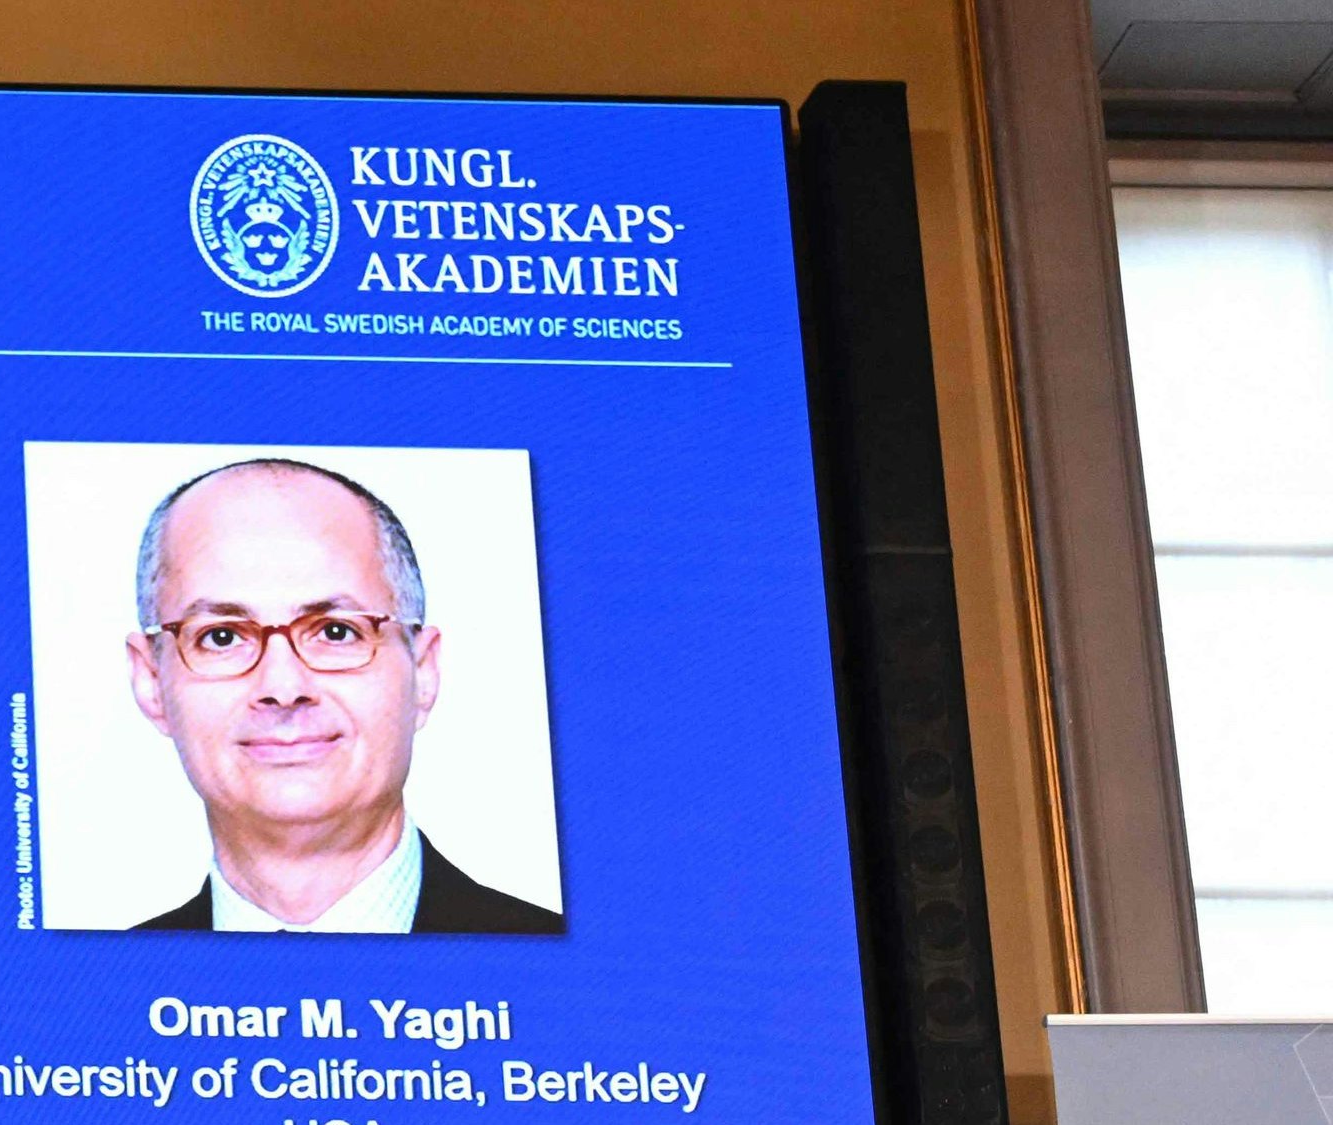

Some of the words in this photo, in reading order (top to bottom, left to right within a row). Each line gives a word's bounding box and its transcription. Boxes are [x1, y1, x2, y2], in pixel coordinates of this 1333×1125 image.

[350, 146, 537, 189] KUNGL.
[351, 199, 685, 244] VETENSKAPS-
[357, 252, 678, 297] AKADEMIEN
[201, 311, 244, 332] THE
[251, 312, 319, 333] ROYAL
[324, 313, 424, 335] SWEDISH
[430, 315, 533, 336] ACADEMY
[539, 317, 567, 337] OF
[572, 318, 682, 340] SCIENCES
[9, 692, 30, 771] California
[12, 771, 30, 790] of
[15, 791, 33, 874] University
[17, 876, 36, 931] Photo:
[148, 996, 288, 1038] Omar
[300, 998, 358, 1039] M.
[369, 999, 511, 1050] Yaghi
[191, 1057, 238, 1099] of
[250, 1057, 486, 1107] California,
[502, 1060, 706, 1114] Berkeley
